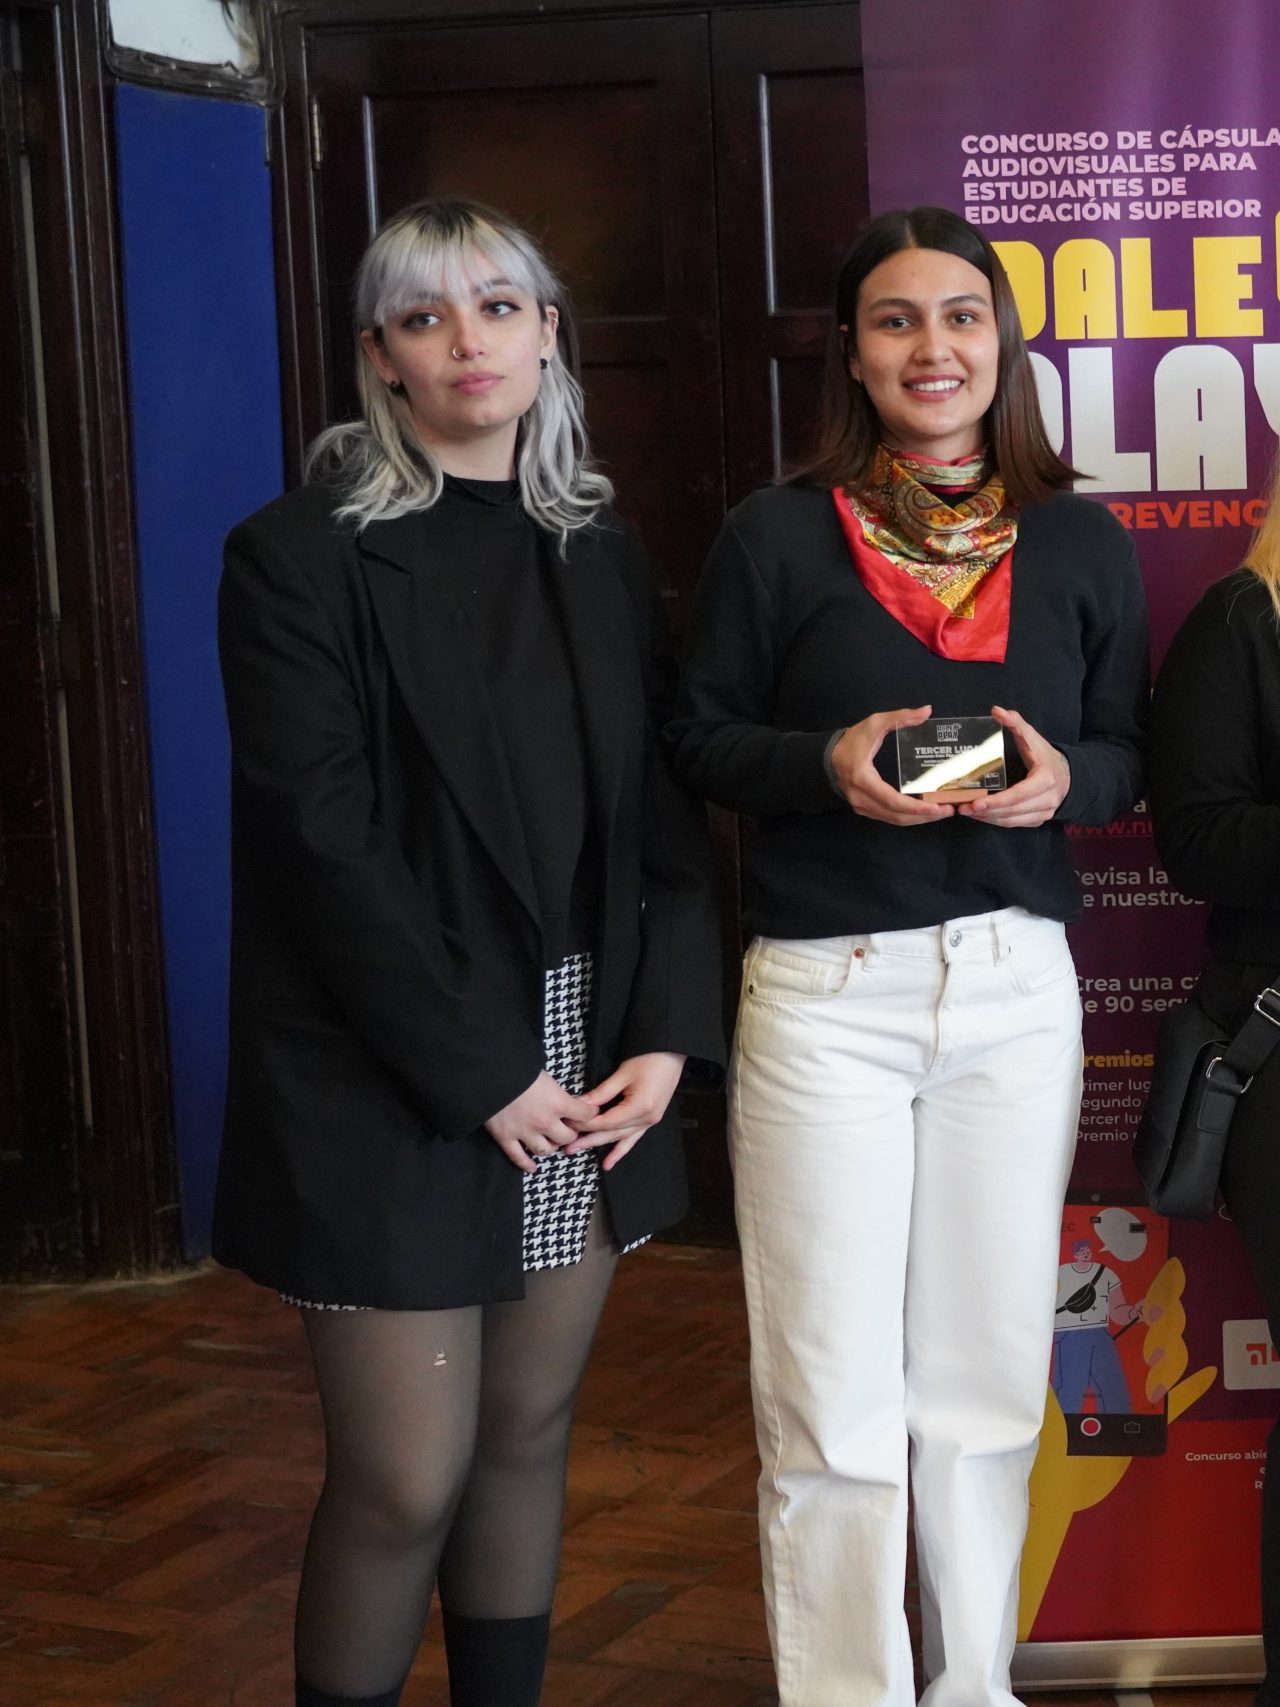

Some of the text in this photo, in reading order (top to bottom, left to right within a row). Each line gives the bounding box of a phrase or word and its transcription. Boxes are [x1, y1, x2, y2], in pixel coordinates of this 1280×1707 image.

[961, 131, 1109, 154] CONCURSO
[1117, 130, 1152, 150] DE
[962, 152, 1256, 177] AUDIOVISUALES PARA
[963, 177, 1187, 201] ESTUDIANTES DE
[964, 198, 1261, 225] EDUCACIÓN SUPERIOR
[914, 746, 952, 755] TERCER
[1074, 867, 1141, 885] evisa
[1129, 977, 1173, 990] una
[1105, 996, 1134, 1012] 90
[1084, 1049, 1154, 1067] remios
[1185, 1452, 1241, 1461] Concurso
